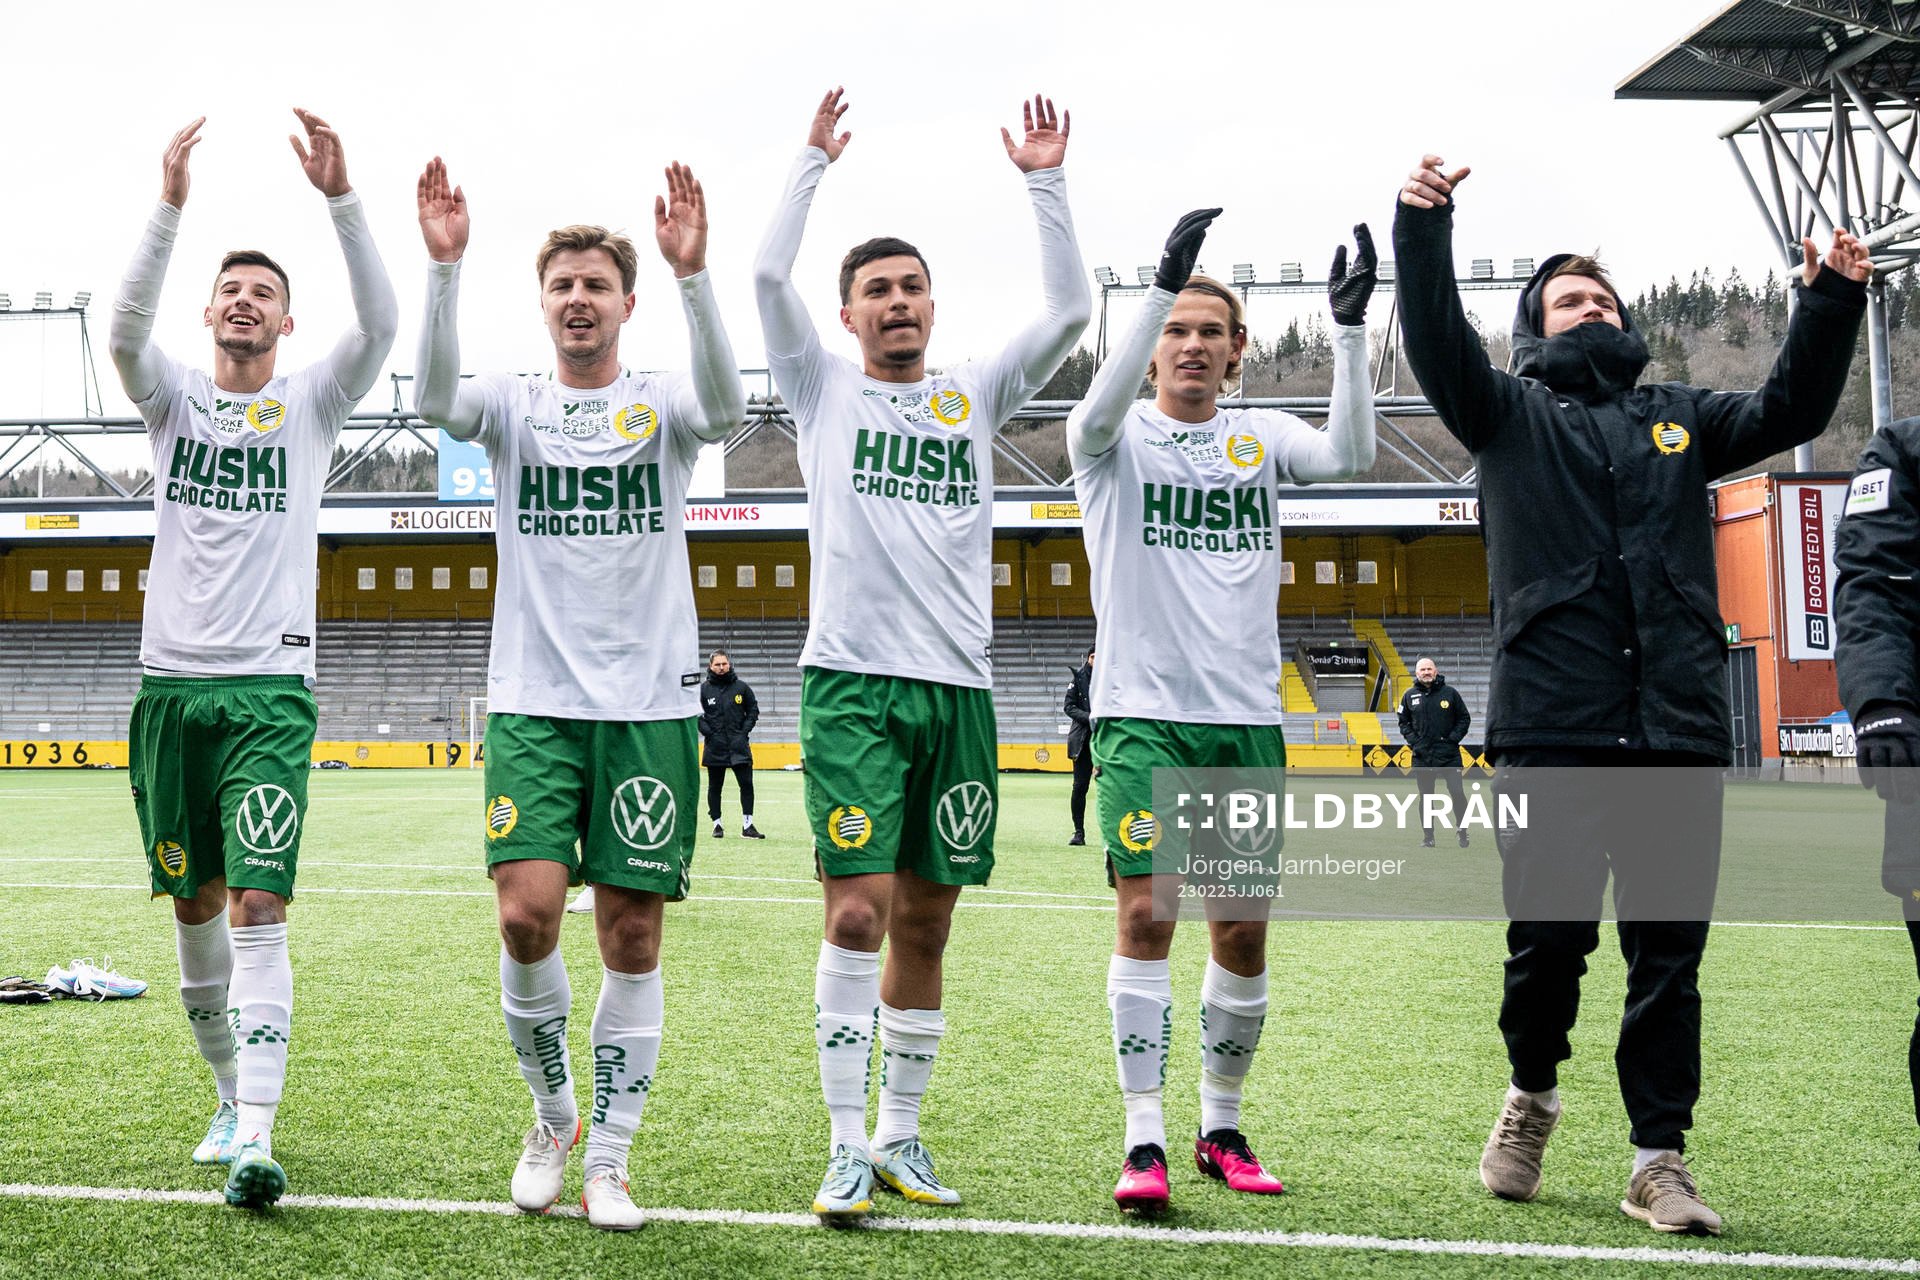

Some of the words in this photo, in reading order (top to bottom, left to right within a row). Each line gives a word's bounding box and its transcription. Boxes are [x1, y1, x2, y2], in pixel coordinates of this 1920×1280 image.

[233, 401, 248, 410] INT
[169, 436, 287, 489] HUSKI
[853, 428, 977, 482] HUSKI
[165, 481, 287, 513] CHOCOLATE
[518, 462, 662, 511] HUSKI
[852, 473, 981, 506] CHOCOLATE
[1143, 482, 1271, 531] HUSKI
[1282, 512, 1309, 520] SSON
[1804, 493, 1818, 518] BIL
[412, 510, 492, 529] LOGICEN
[518, 511, 664, 536] CHOCOLATE
[1143, 526, 1273, 552] CHOCOLATE
[1806, 524, 1823, 608] BOGSTEDT
[4, 742, 88, 764] 1936
[1835, 726, 1857, 755] ello
[244, 857, 279, 868] CRAFT
[627, 857, 662, 870] CRAFT
[593, 1044, 626, 1125] Clinton
